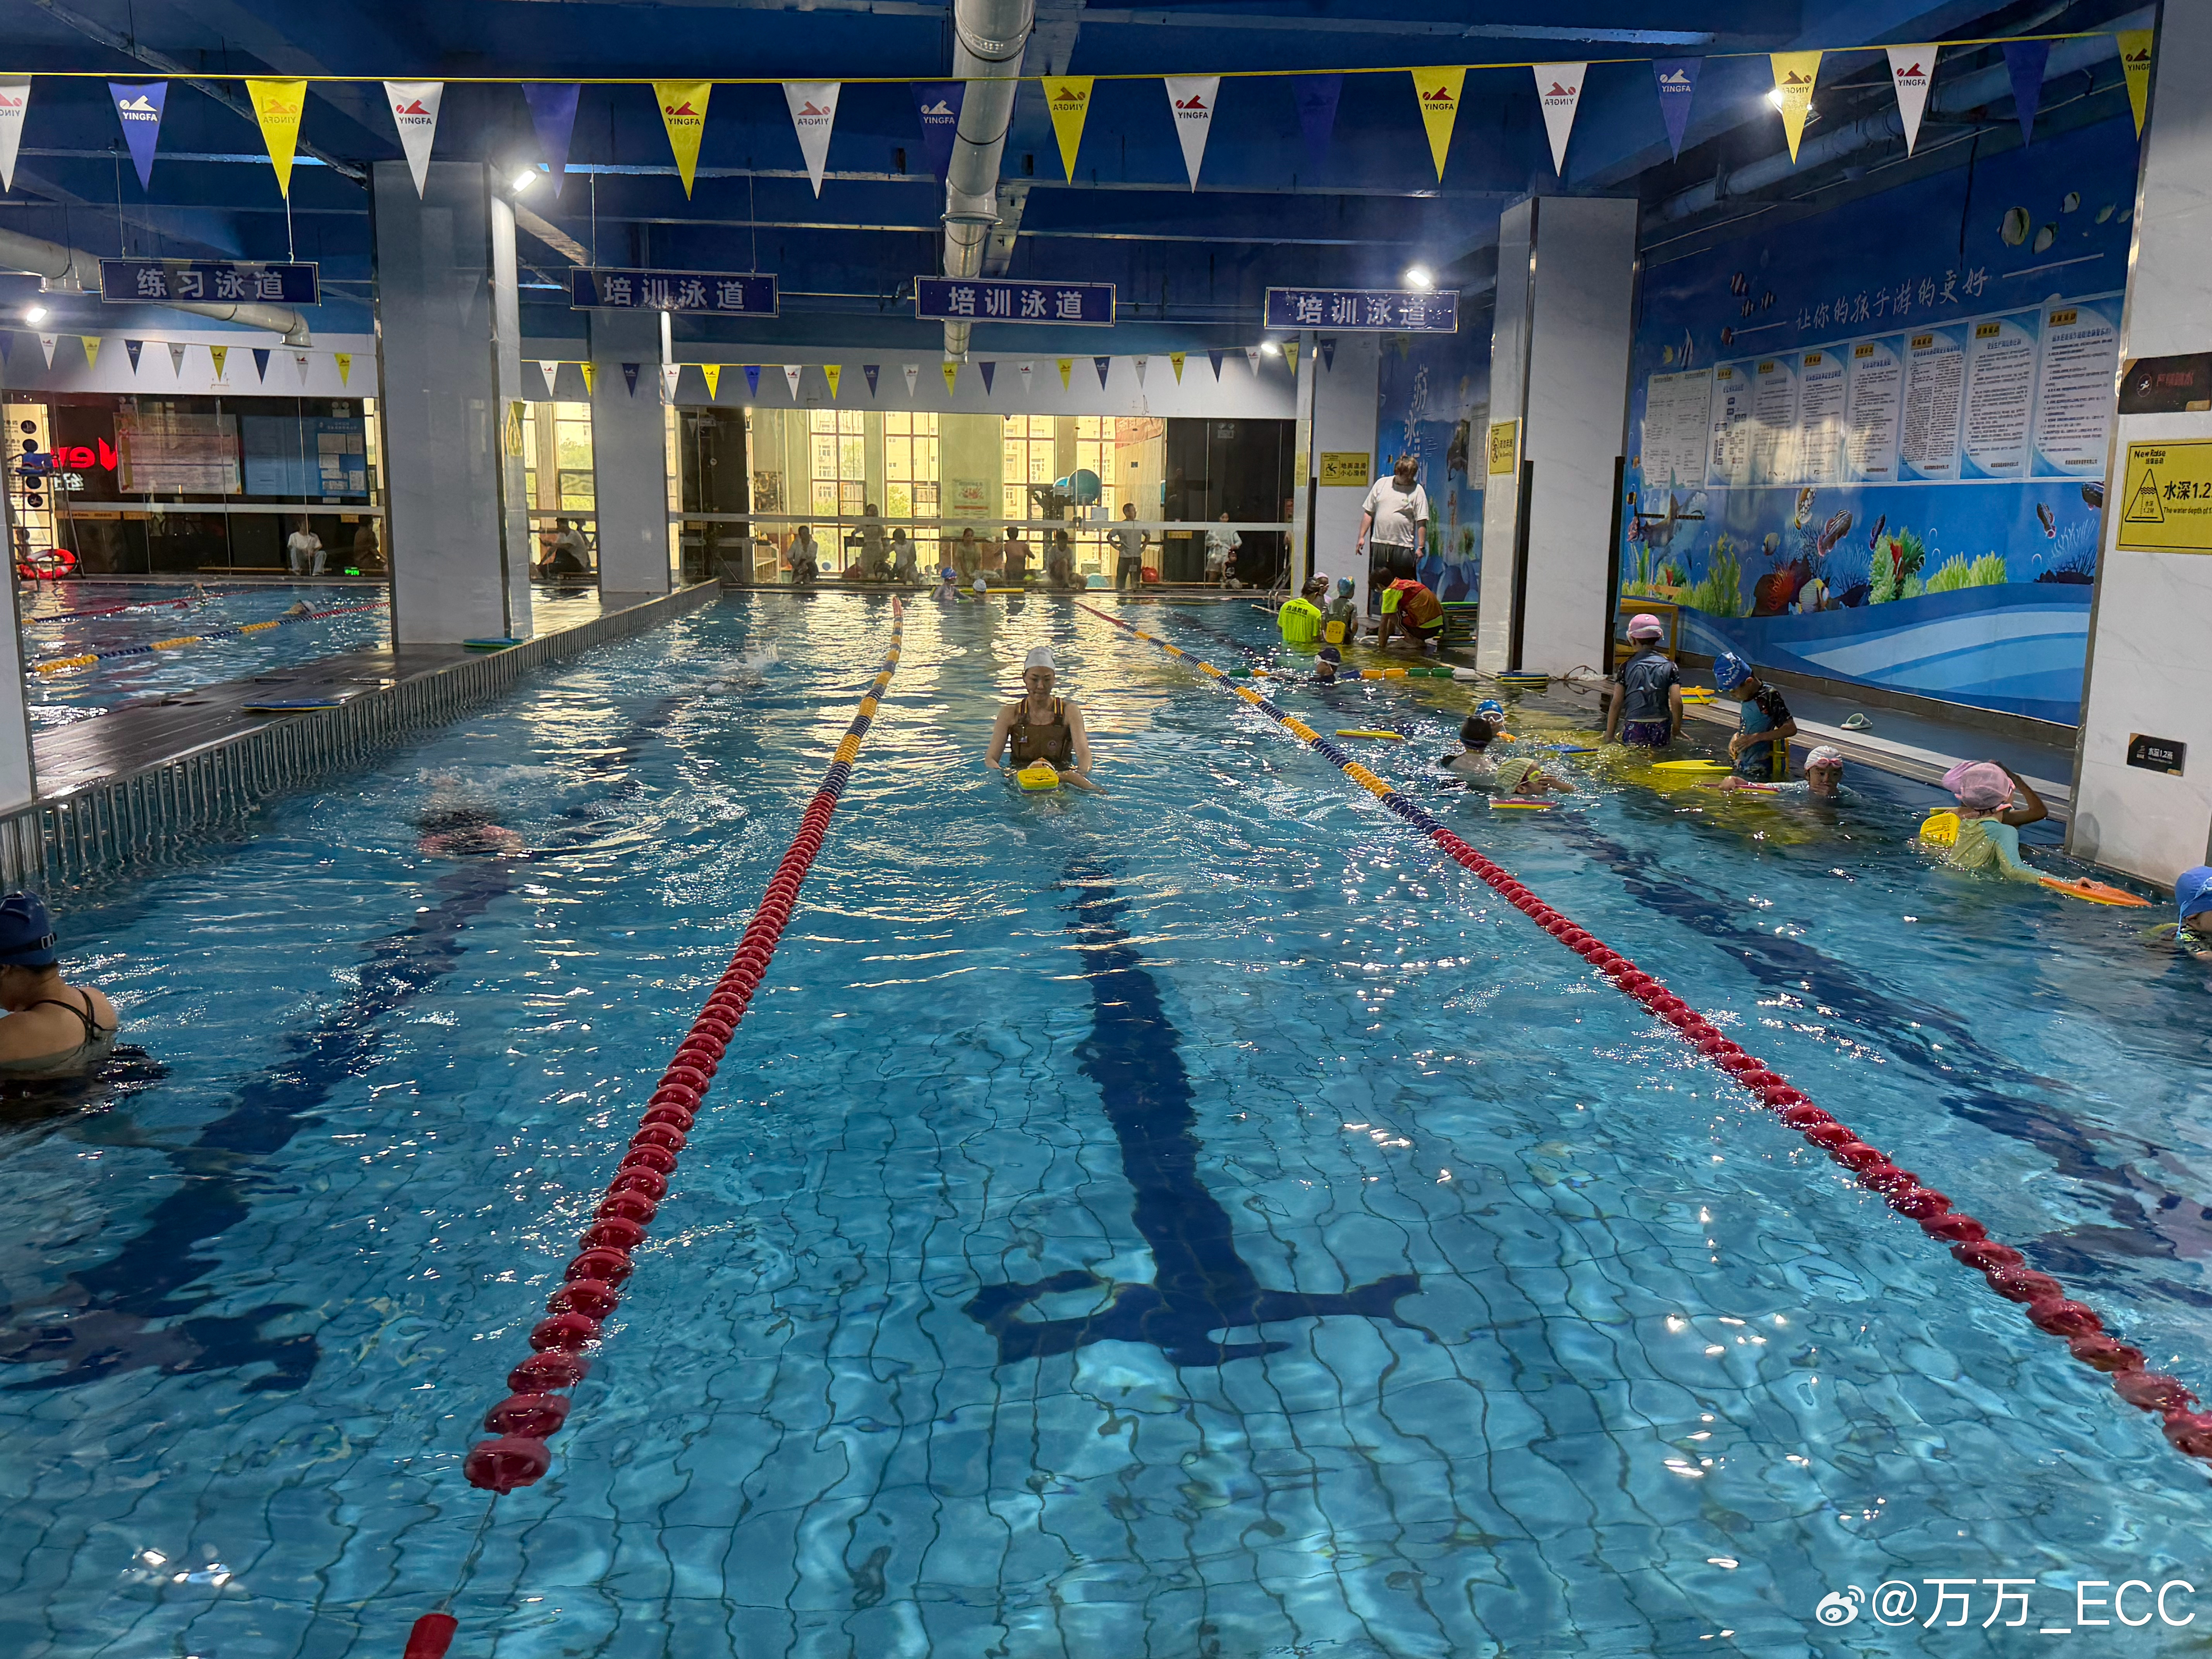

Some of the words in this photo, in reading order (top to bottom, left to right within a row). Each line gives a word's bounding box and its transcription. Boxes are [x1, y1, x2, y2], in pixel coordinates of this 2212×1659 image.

[122, 111, 158, 121] YINGFA
[923, 116, 955, 124] YINGFA
[137, 269, 285, 299] 练习泳道
[603, 276, 745, 310] 培训泳道
[948, 286, 1083, 319] 培训泳道
[1297, 297, 1427, 327] 培训泳道
[2163, 480, 2212, 500] 水深1.2
